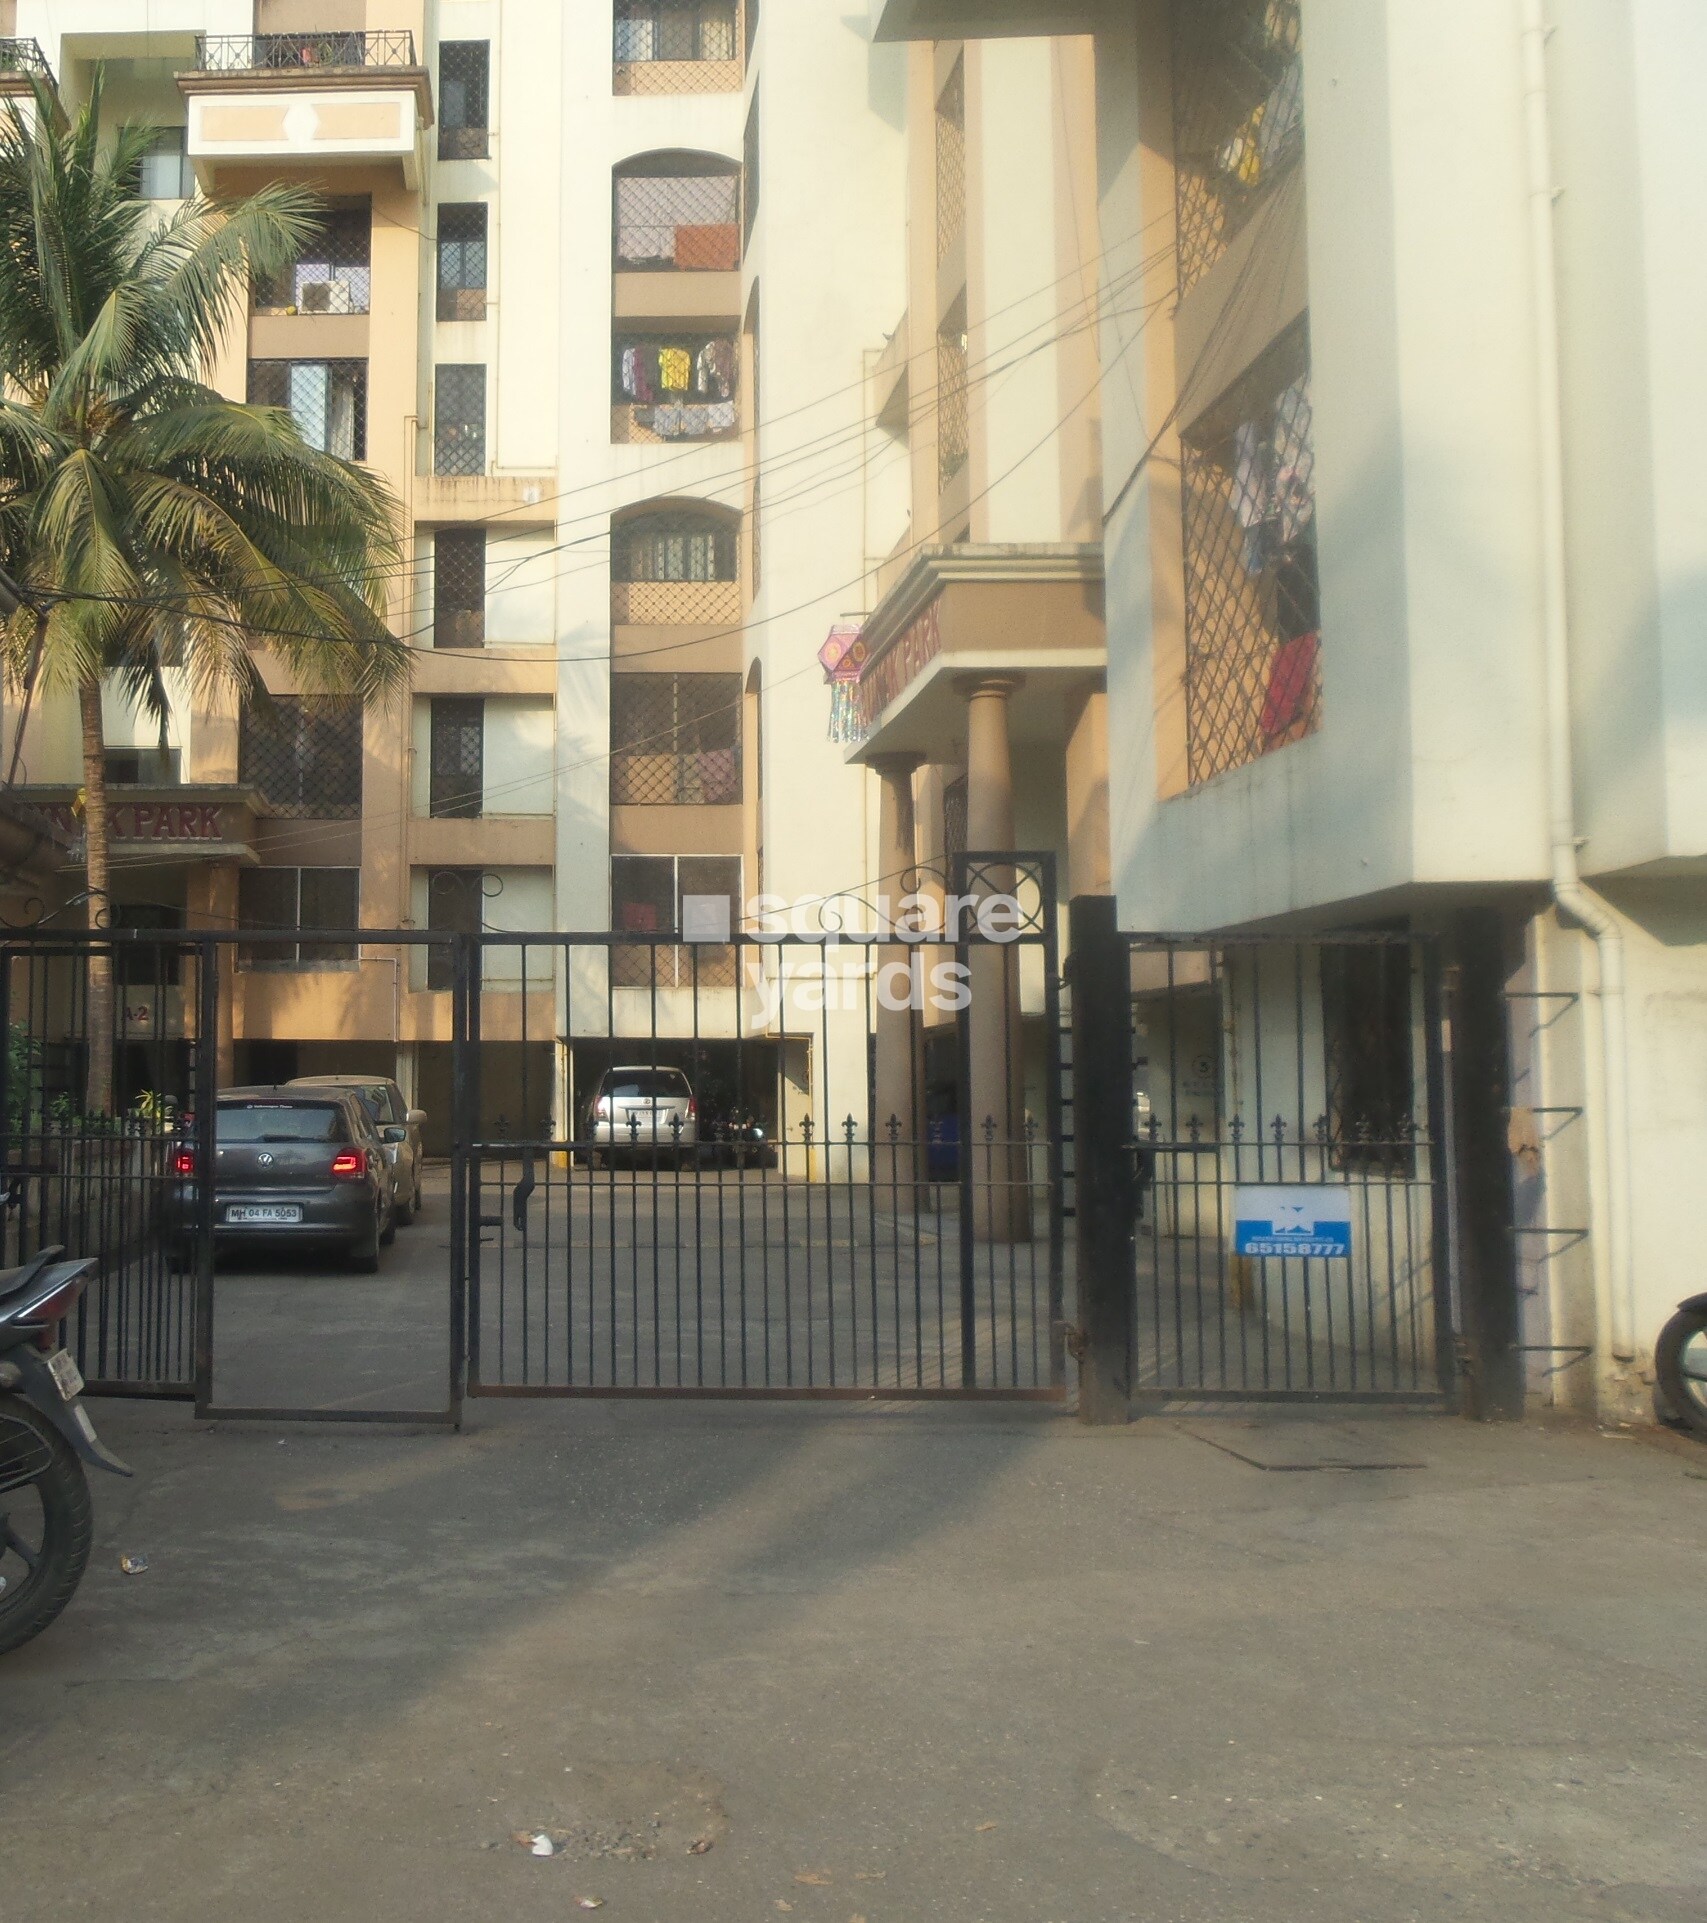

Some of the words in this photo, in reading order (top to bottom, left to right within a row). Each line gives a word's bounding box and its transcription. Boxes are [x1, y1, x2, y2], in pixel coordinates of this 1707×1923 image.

[132, 802, 223, 840] PARK
[231, 1209, 246, 1217] MH
[248, 1208, 260, 1217] 04
[262, 1208, 273, 1217] FA
[275, 1208, 297, 1217] 5053
